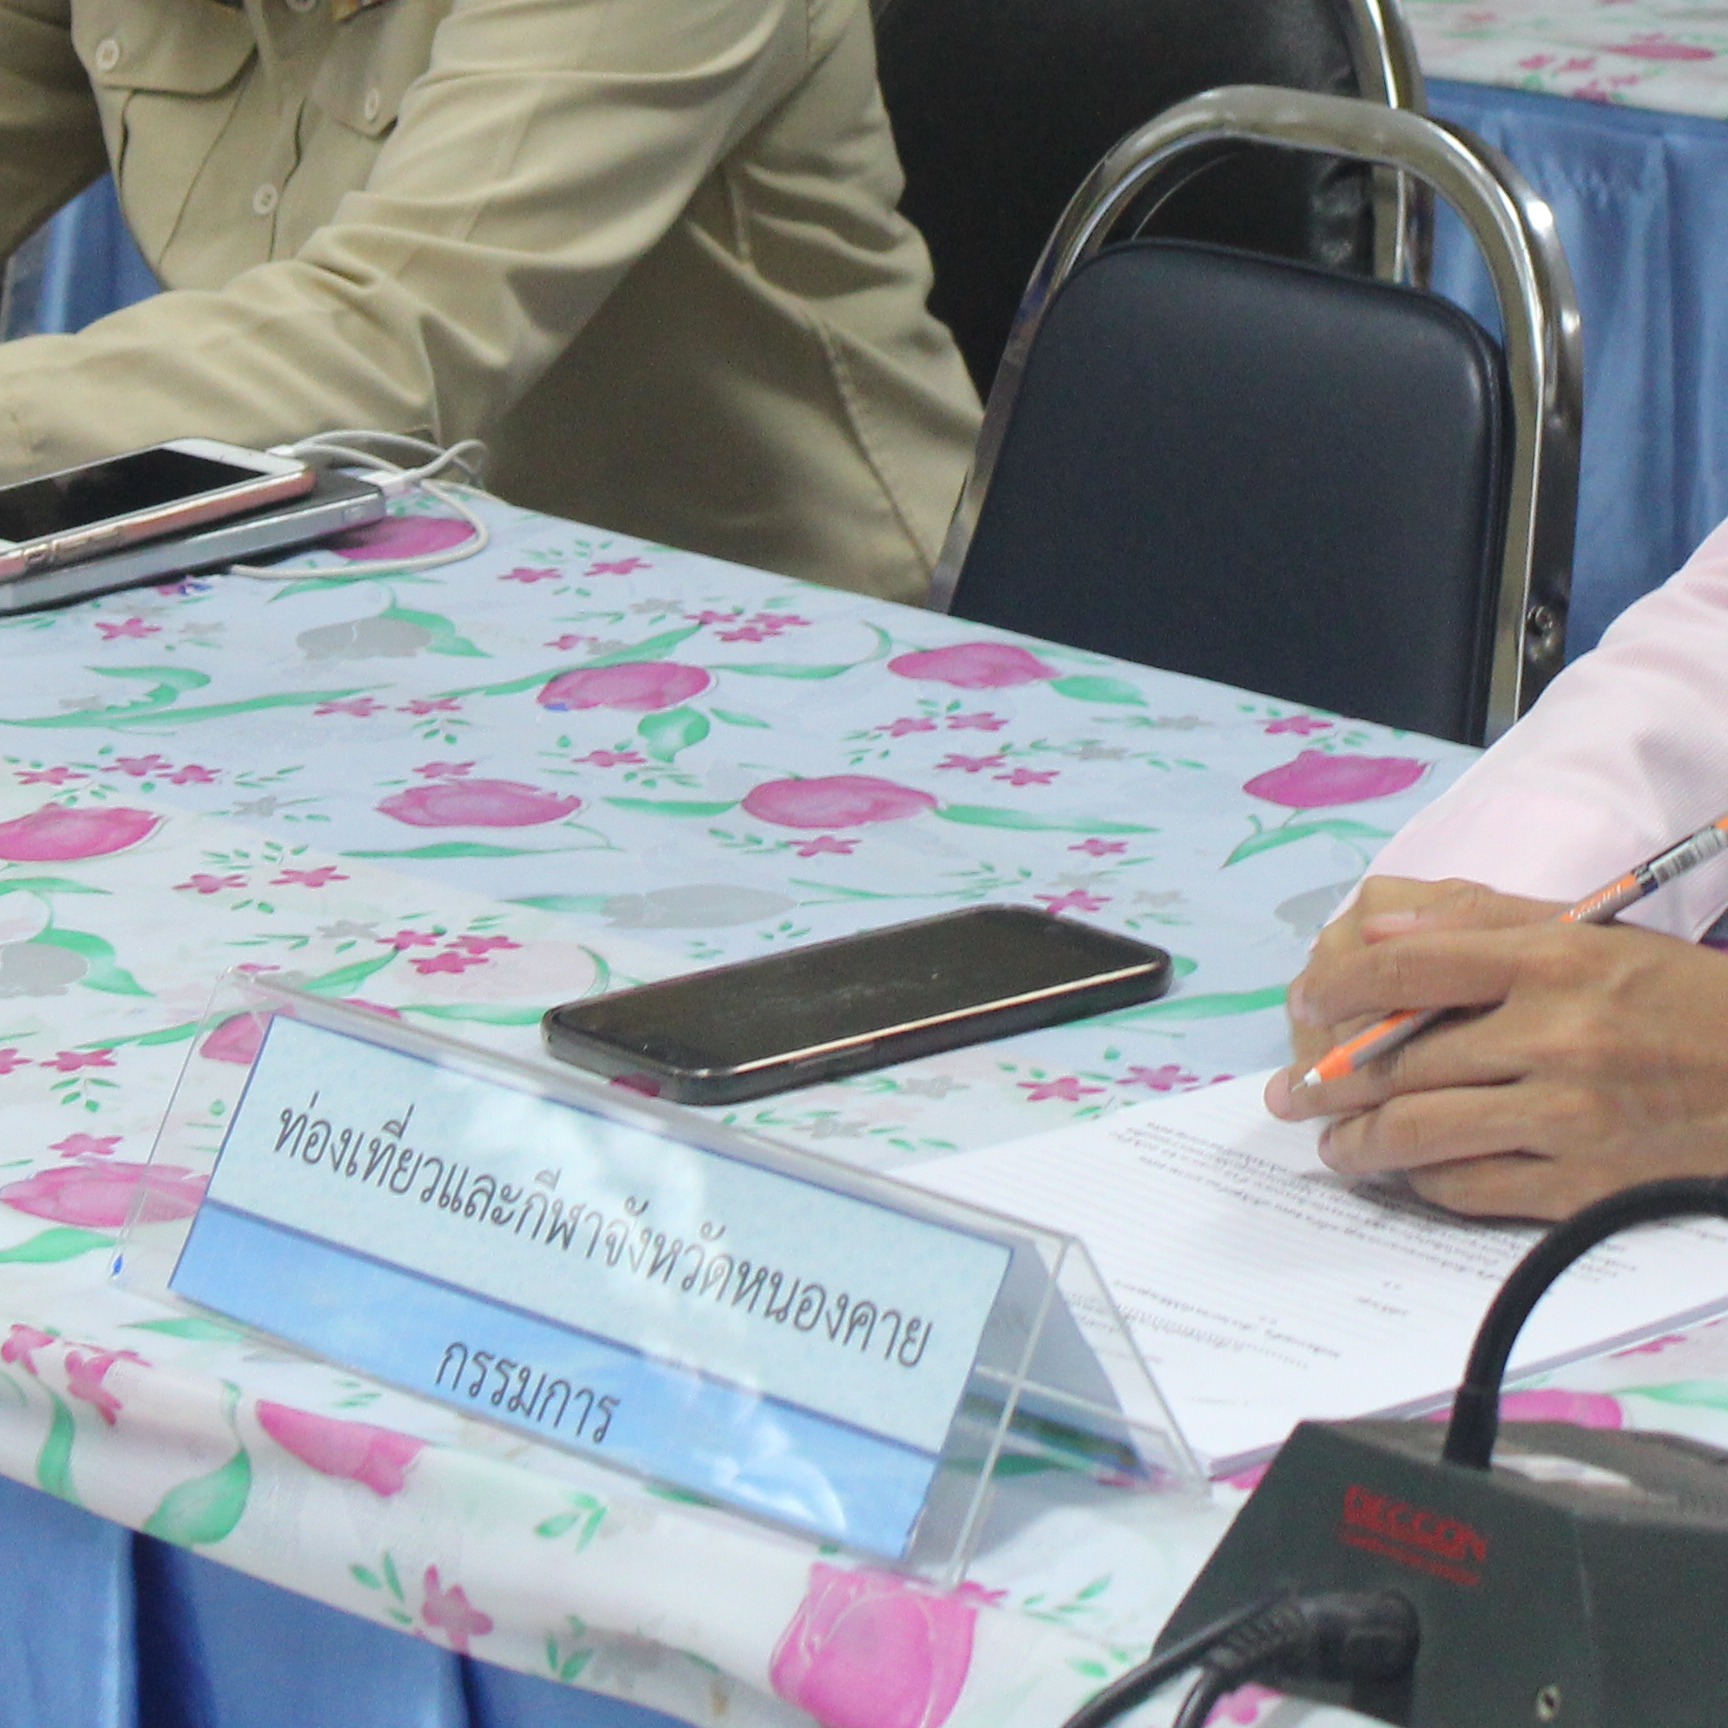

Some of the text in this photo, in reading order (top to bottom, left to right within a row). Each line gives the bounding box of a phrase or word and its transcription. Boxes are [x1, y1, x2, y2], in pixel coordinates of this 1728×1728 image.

[272, 1092, 934, 1369] ท่องเที่ยวและกีฬาจังหวัดหนองคาย
[434, 1340, 623, 1445] กรรมการ
